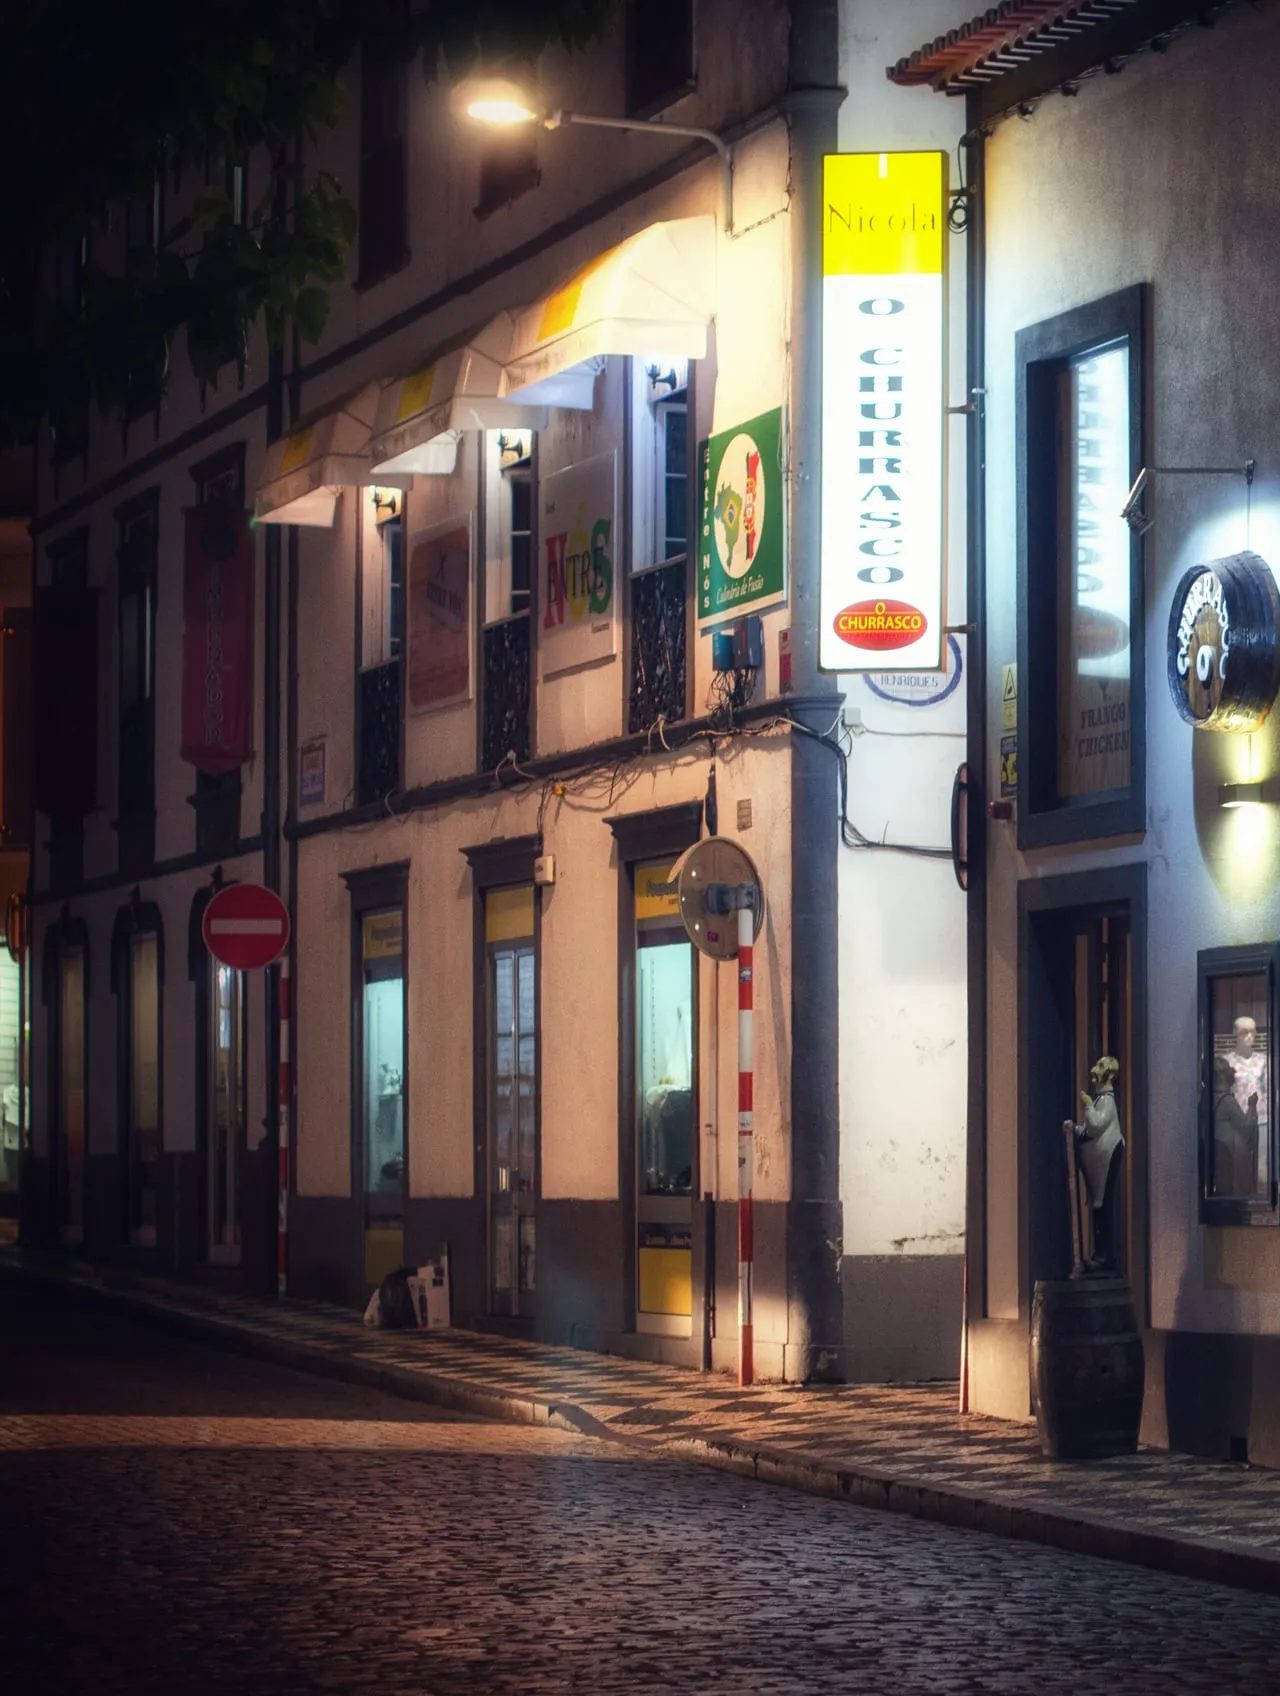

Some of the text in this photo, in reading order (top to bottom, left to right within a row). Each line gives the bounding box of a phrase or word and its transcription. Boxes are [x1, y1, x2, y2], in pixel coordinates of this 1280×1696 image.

[827, 201, 936, 233] Nicola
[857, 297, 905, 317] O
[857, 347, 905, 586] CHURRASCO
[838, 615, 922, 631] CHURRASCO
[874, 601, 887, 616] O
[1196, 644, 1214, 683] O
[1080, 702, 1127, 730] FRANGO
[1078, 729, 1130, 759] CHICKEN
